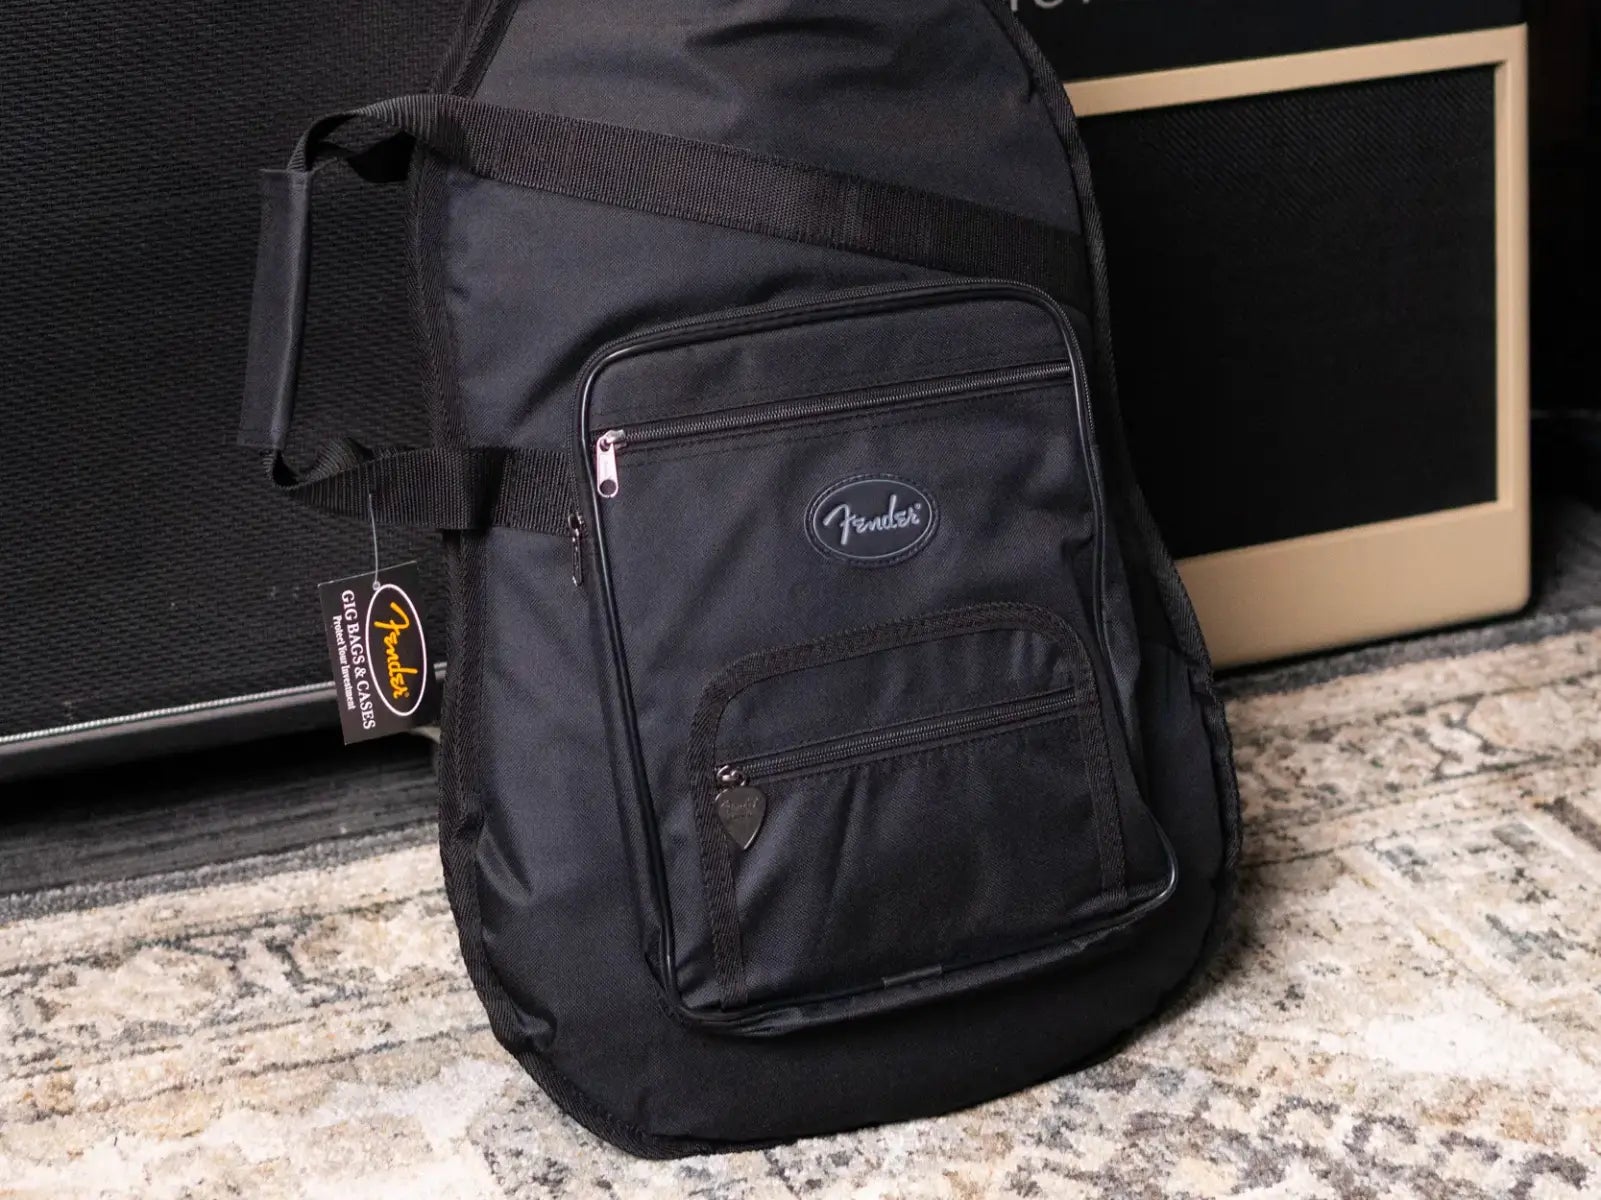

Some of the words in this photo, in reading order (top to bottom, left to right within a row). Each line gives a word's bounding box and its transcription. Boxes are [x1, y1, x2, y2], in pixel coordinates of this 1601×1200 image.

[823, 494, 921, 546] Fender
[341, 590, 359, 622] GIG
[332, 615, 345, 647] Protect
[347, 623, 366, 664] BAGS
[373, 602, 418, 700] Fender
[339, 646, 349, 668] Your
[354, 664, 368, 680] &
[341, 665, 356, 711] Investment
[356, 680, 376, 730] CASES
